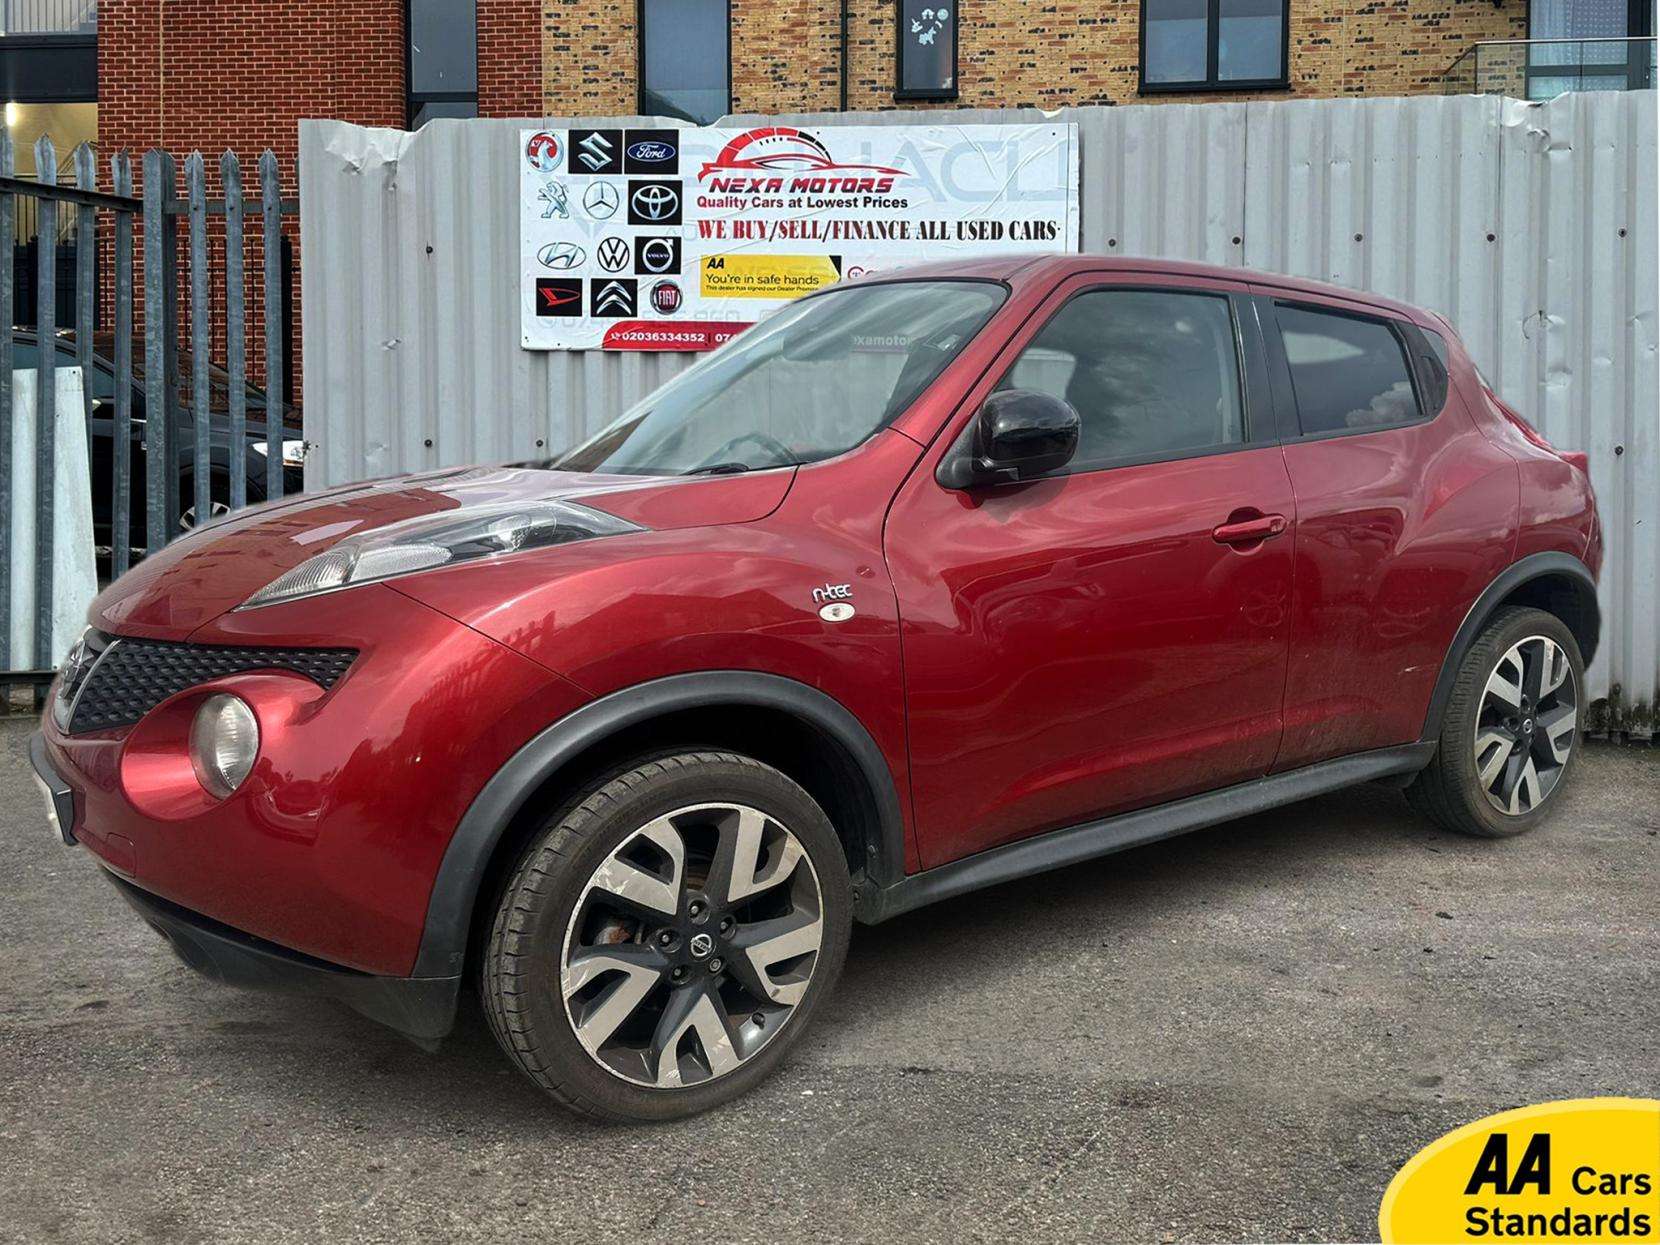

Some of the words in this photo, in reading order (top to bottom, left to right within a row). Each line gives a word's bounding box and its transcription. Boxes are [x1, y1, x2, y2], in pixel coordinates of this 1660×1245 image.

[636, 145, 667, 158] Ford
[709, 177, 784, 194] NEXA
[789, 177, 894, 194] MOTORS
[697, 196, 747, 210] Quality
[752, 196, 784, 209] Cars
[788, 197, 803, 209] at
[807, 196, 859, 209] Lowest
[863, 196, 908, 209] Prices
[698, 220, 727, 240] WE
[733, 219, 911, 243] BUY/SELL/FINANCE
[916, 220, 951, 241] ALL
[957, 220, 1004, 241] USED
[1009, 220, 1057, 241] CARS
[707, 257, 725, 269] AA
[706, 273, 741, 285] You're
[744, 274, 754, 284] in
[757, 274, 781, 284] safe
[784, 274, 820, 286] hands
[659, 291, 678, 306] FIAT
[622, 332, 705, 342] 02036334352
